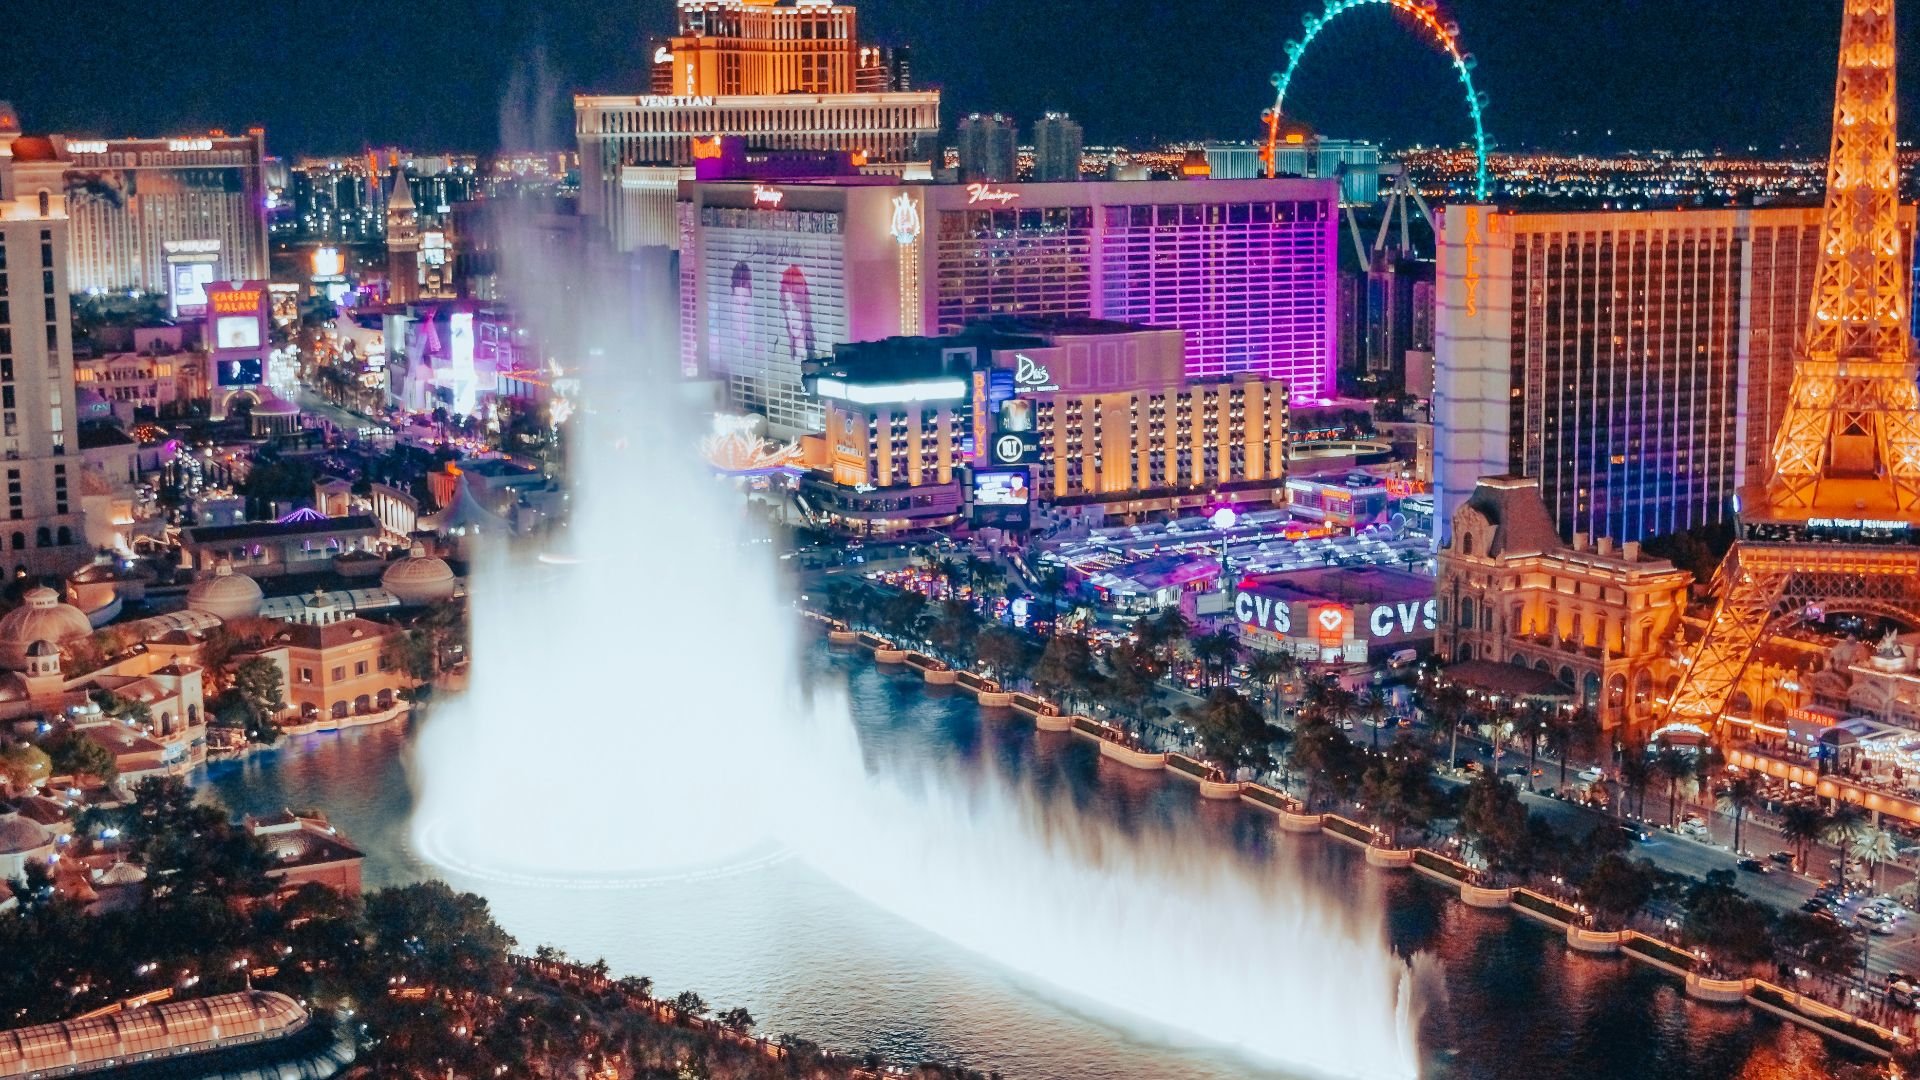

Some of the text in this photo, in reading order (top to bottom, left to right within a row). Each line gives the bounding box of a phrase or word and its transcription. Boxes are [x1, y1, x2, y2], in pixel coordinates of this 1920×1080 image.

[640, 95, 713, 107] VENETIAN
[753, 184, 783, 208] Flamingo
[966, 183, 1020, 205] Flamingo
[214, 301, 258, 312] PALACE
[1002, 440, 1018, 457] BLT
[1807, 517, 1908, 530] EIFFEL TOWER RESTAURANT
[1235, 591, 1292, 633] CVS
[1370, 599, 1437, 637] CVS
[1788, 708, 1836, 727] BEER PARK
